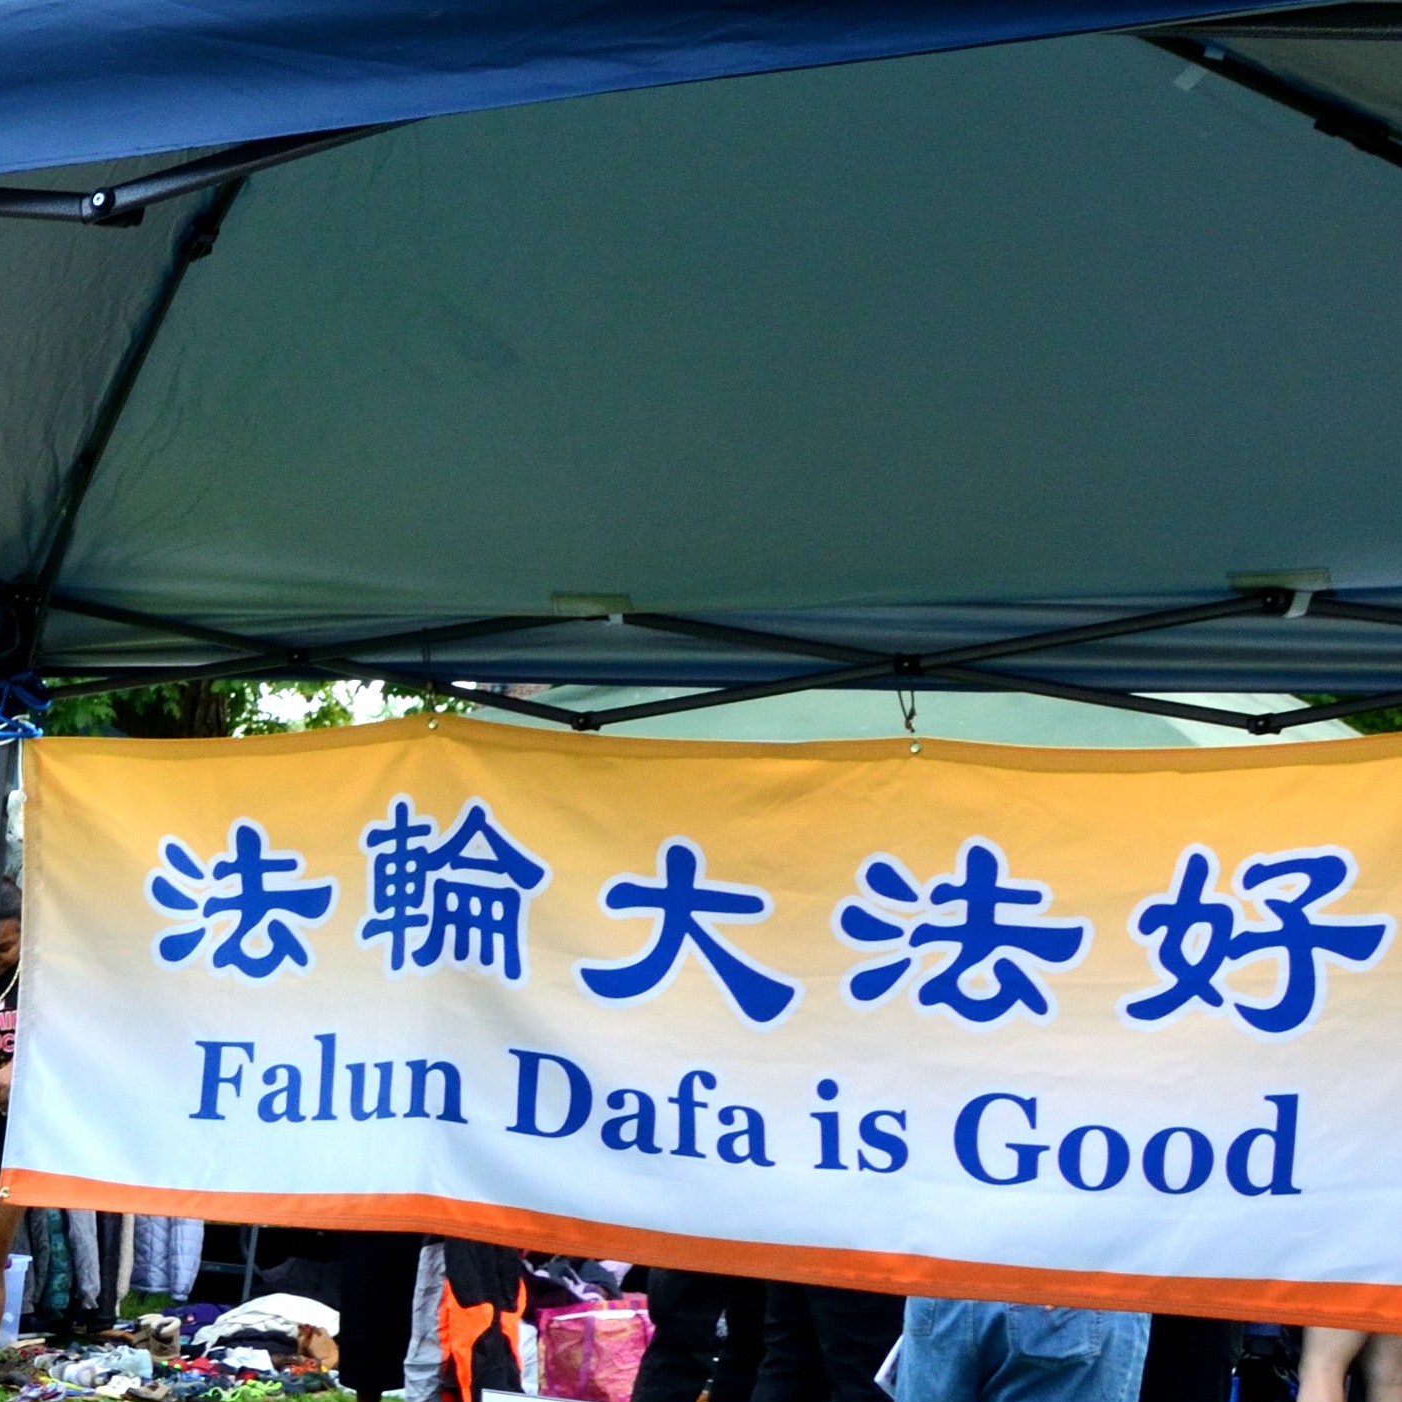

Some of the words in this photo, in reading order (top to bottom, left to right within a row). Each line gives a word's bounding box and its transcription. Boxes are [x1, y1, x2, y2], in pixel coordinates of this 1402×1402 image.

[152, 801, 1387, 1033] 法輪大法好
[190, 1033, 468, 1124] Falun
[506, 1048, 775, 1167] Dafa
[811, 1078, 909, 1174] is
[954, 1092, 1302, 1197] Good
